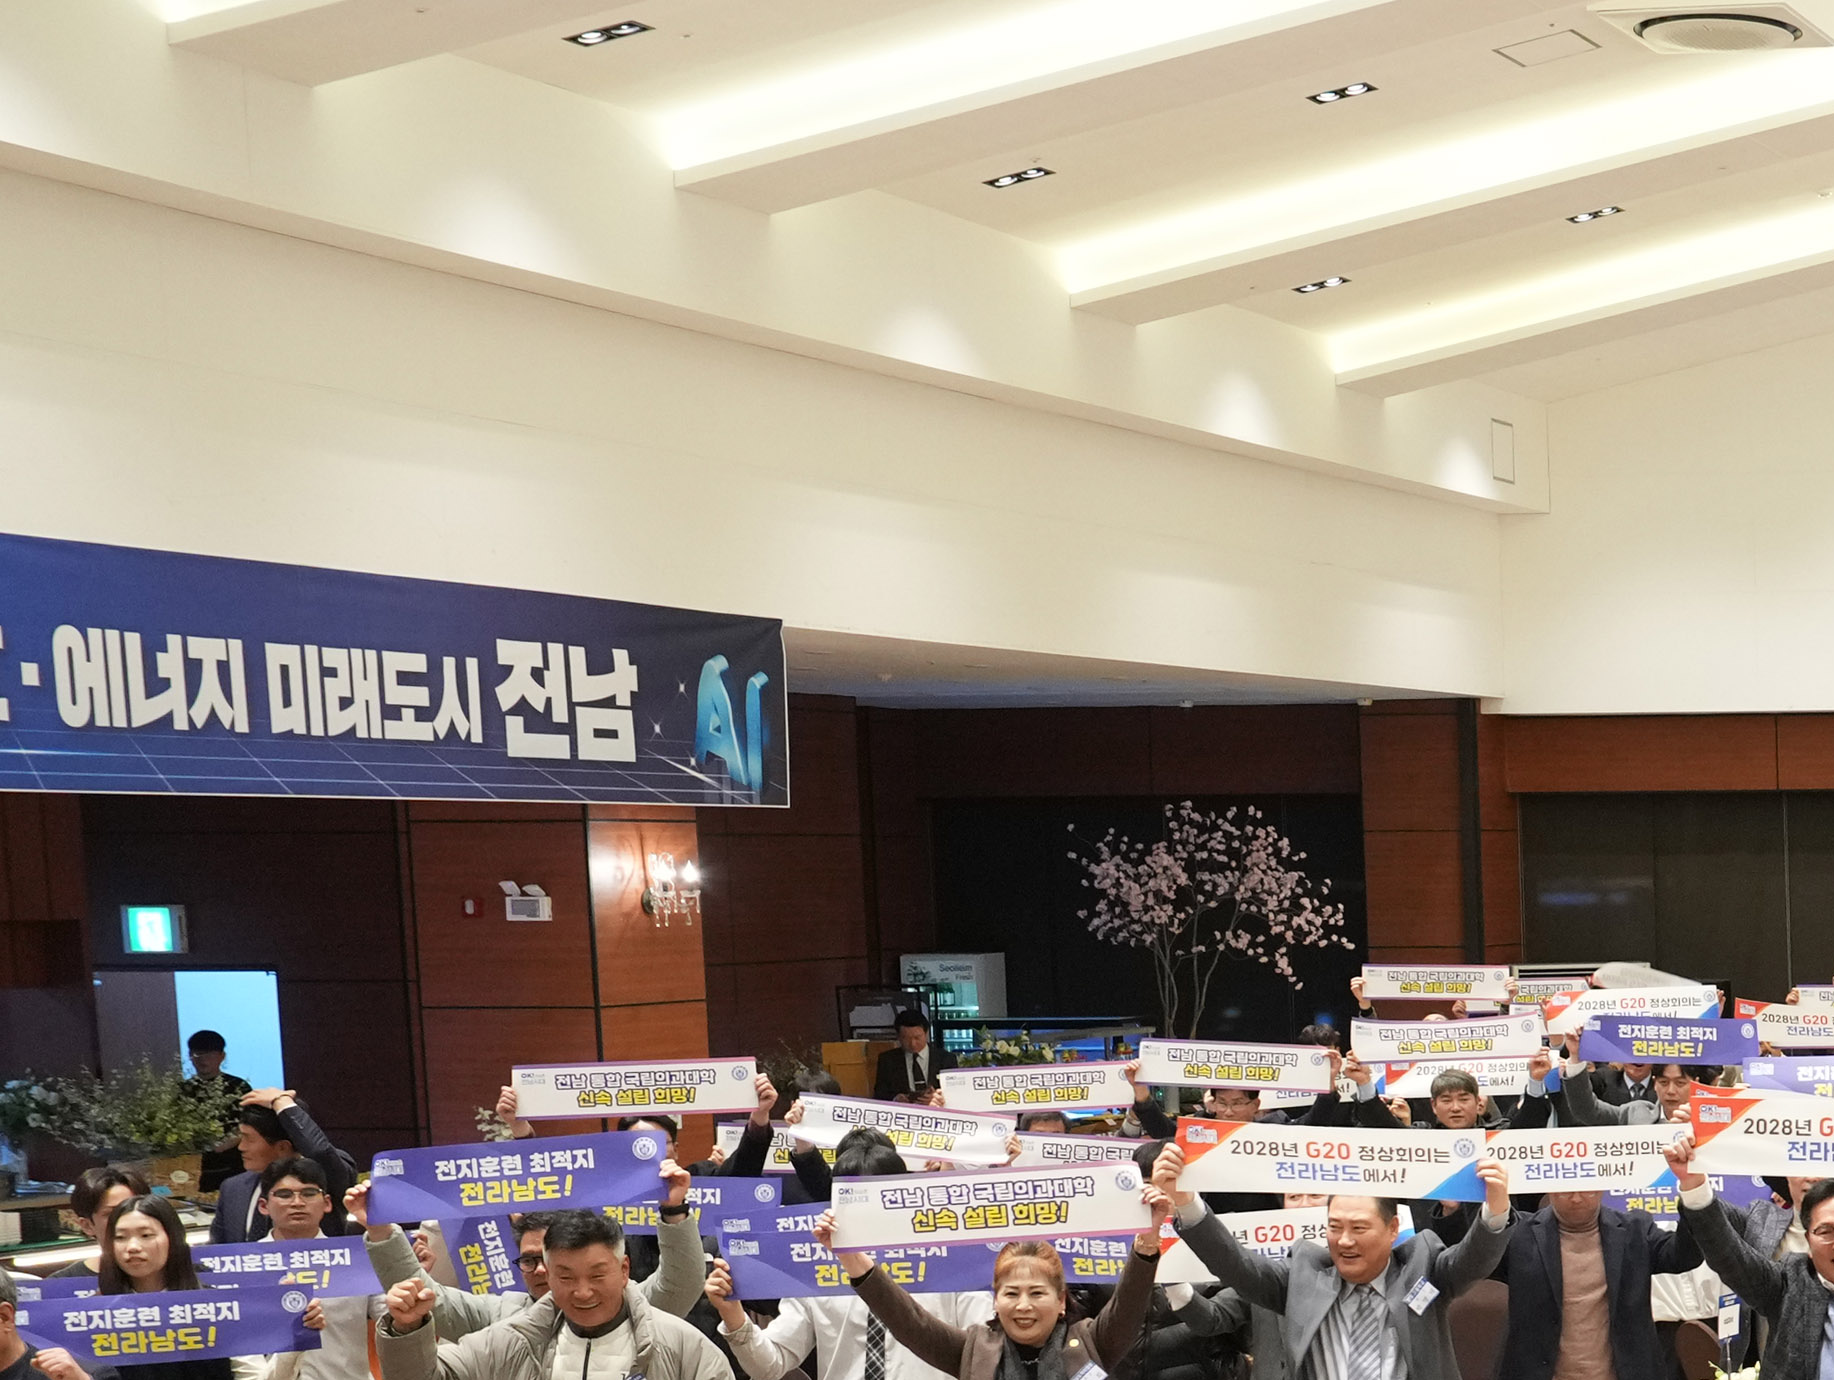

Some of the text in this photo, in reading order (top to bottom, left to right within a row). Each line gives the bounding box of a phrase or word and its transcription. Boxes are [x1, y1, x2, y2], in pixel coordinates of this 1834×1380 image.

[265, 642, 483, 744] 미래도시
[495, 638, 639, 763] 전남
[695, 653, 769, 791] AI
[1743, 1118, 1813, 1138] 2028년
[1230, 1139, 1451, 1165] 2028년 G20 정상회의는
[1275, 1161, 1407, 1184] 전라남도에서!
[882, 1176, 1095, 1209] 전남 통합 국립의과대학
[912, 1202, 1068, 1233] 신속 설립 희망!
[63, 1301, 241, 1333] 전지훈련 최적지
[91, 1327, 218, 1357] 전라남도!
